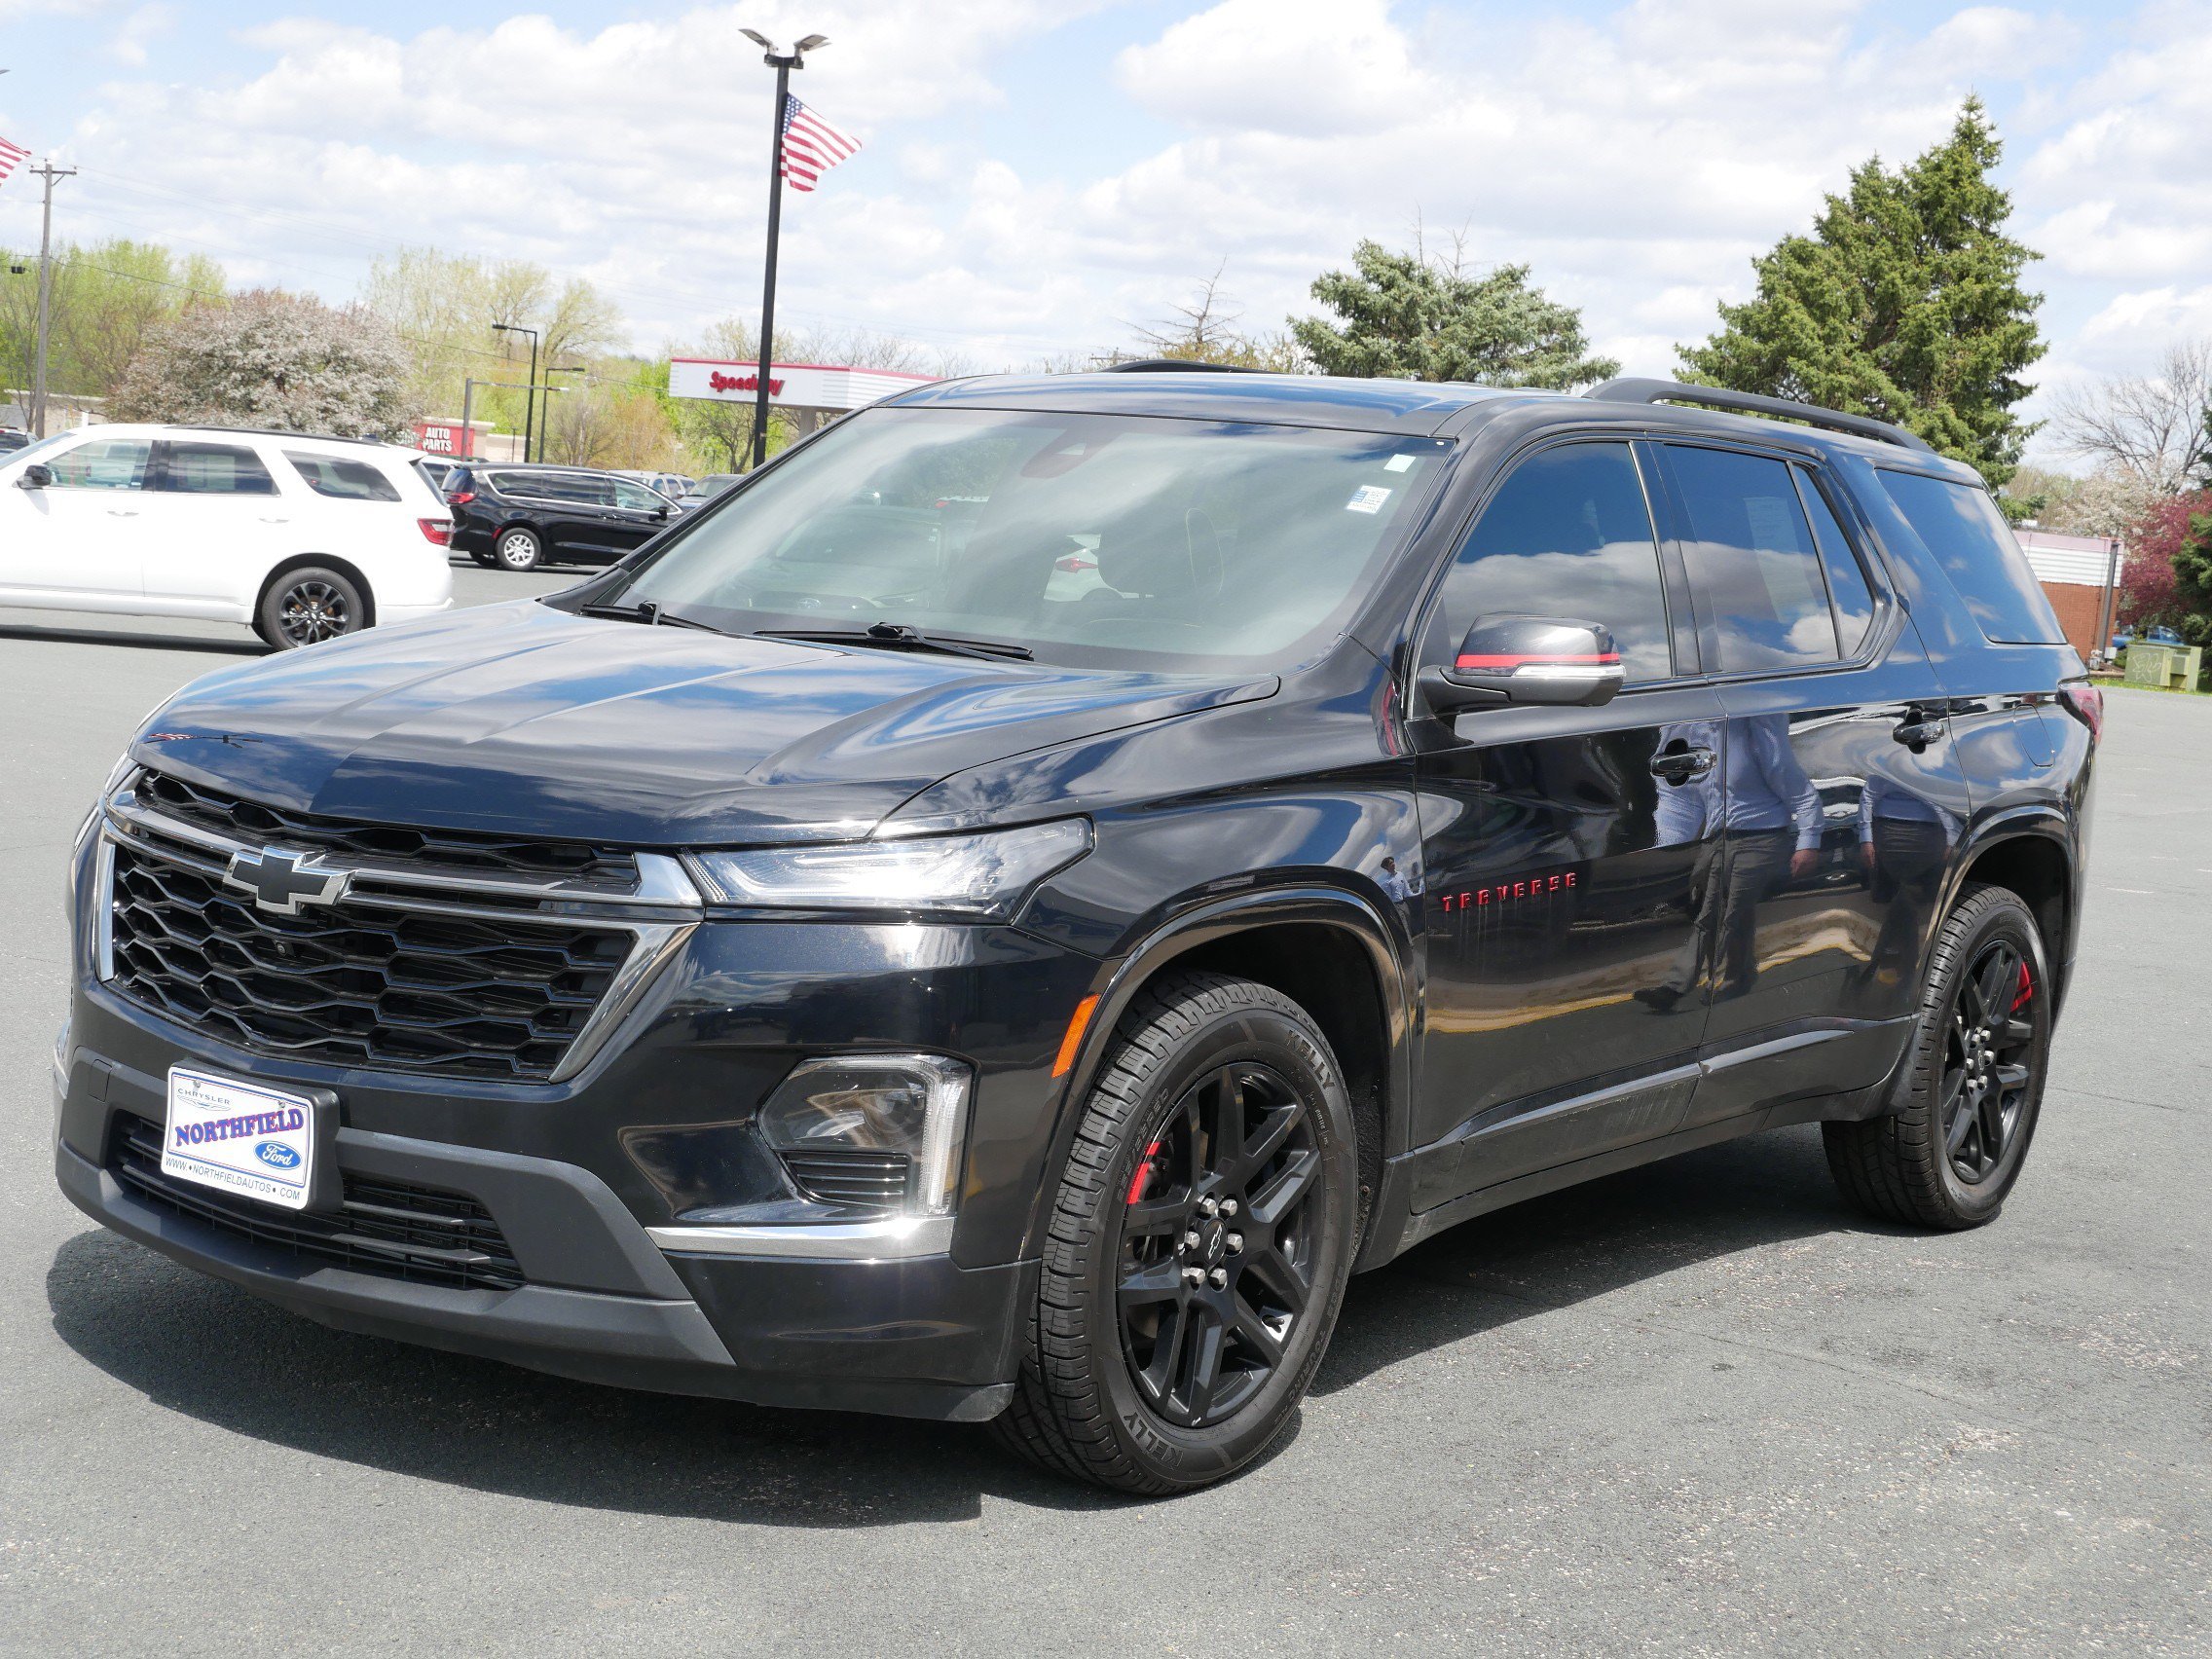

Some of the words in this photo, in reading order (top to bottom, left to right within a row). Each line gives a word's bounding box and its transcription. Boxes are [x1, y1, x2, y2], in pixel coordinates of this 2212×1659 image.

[422, 438, 453, 453] PARTS
[425, 426, 451, 440] AUTO
[1442, 871, 1577, 912] TRAVERSE
[1286, 1029, 1336, 1090] KELLY
[177, 1088, 231, 1105] CHRYSLER
[174, 1108, 305, 1147] NORTHFIELD
[262, 1143, 293, 1166] Ford
[1123, 1412, 1184, 1467] KELLY
